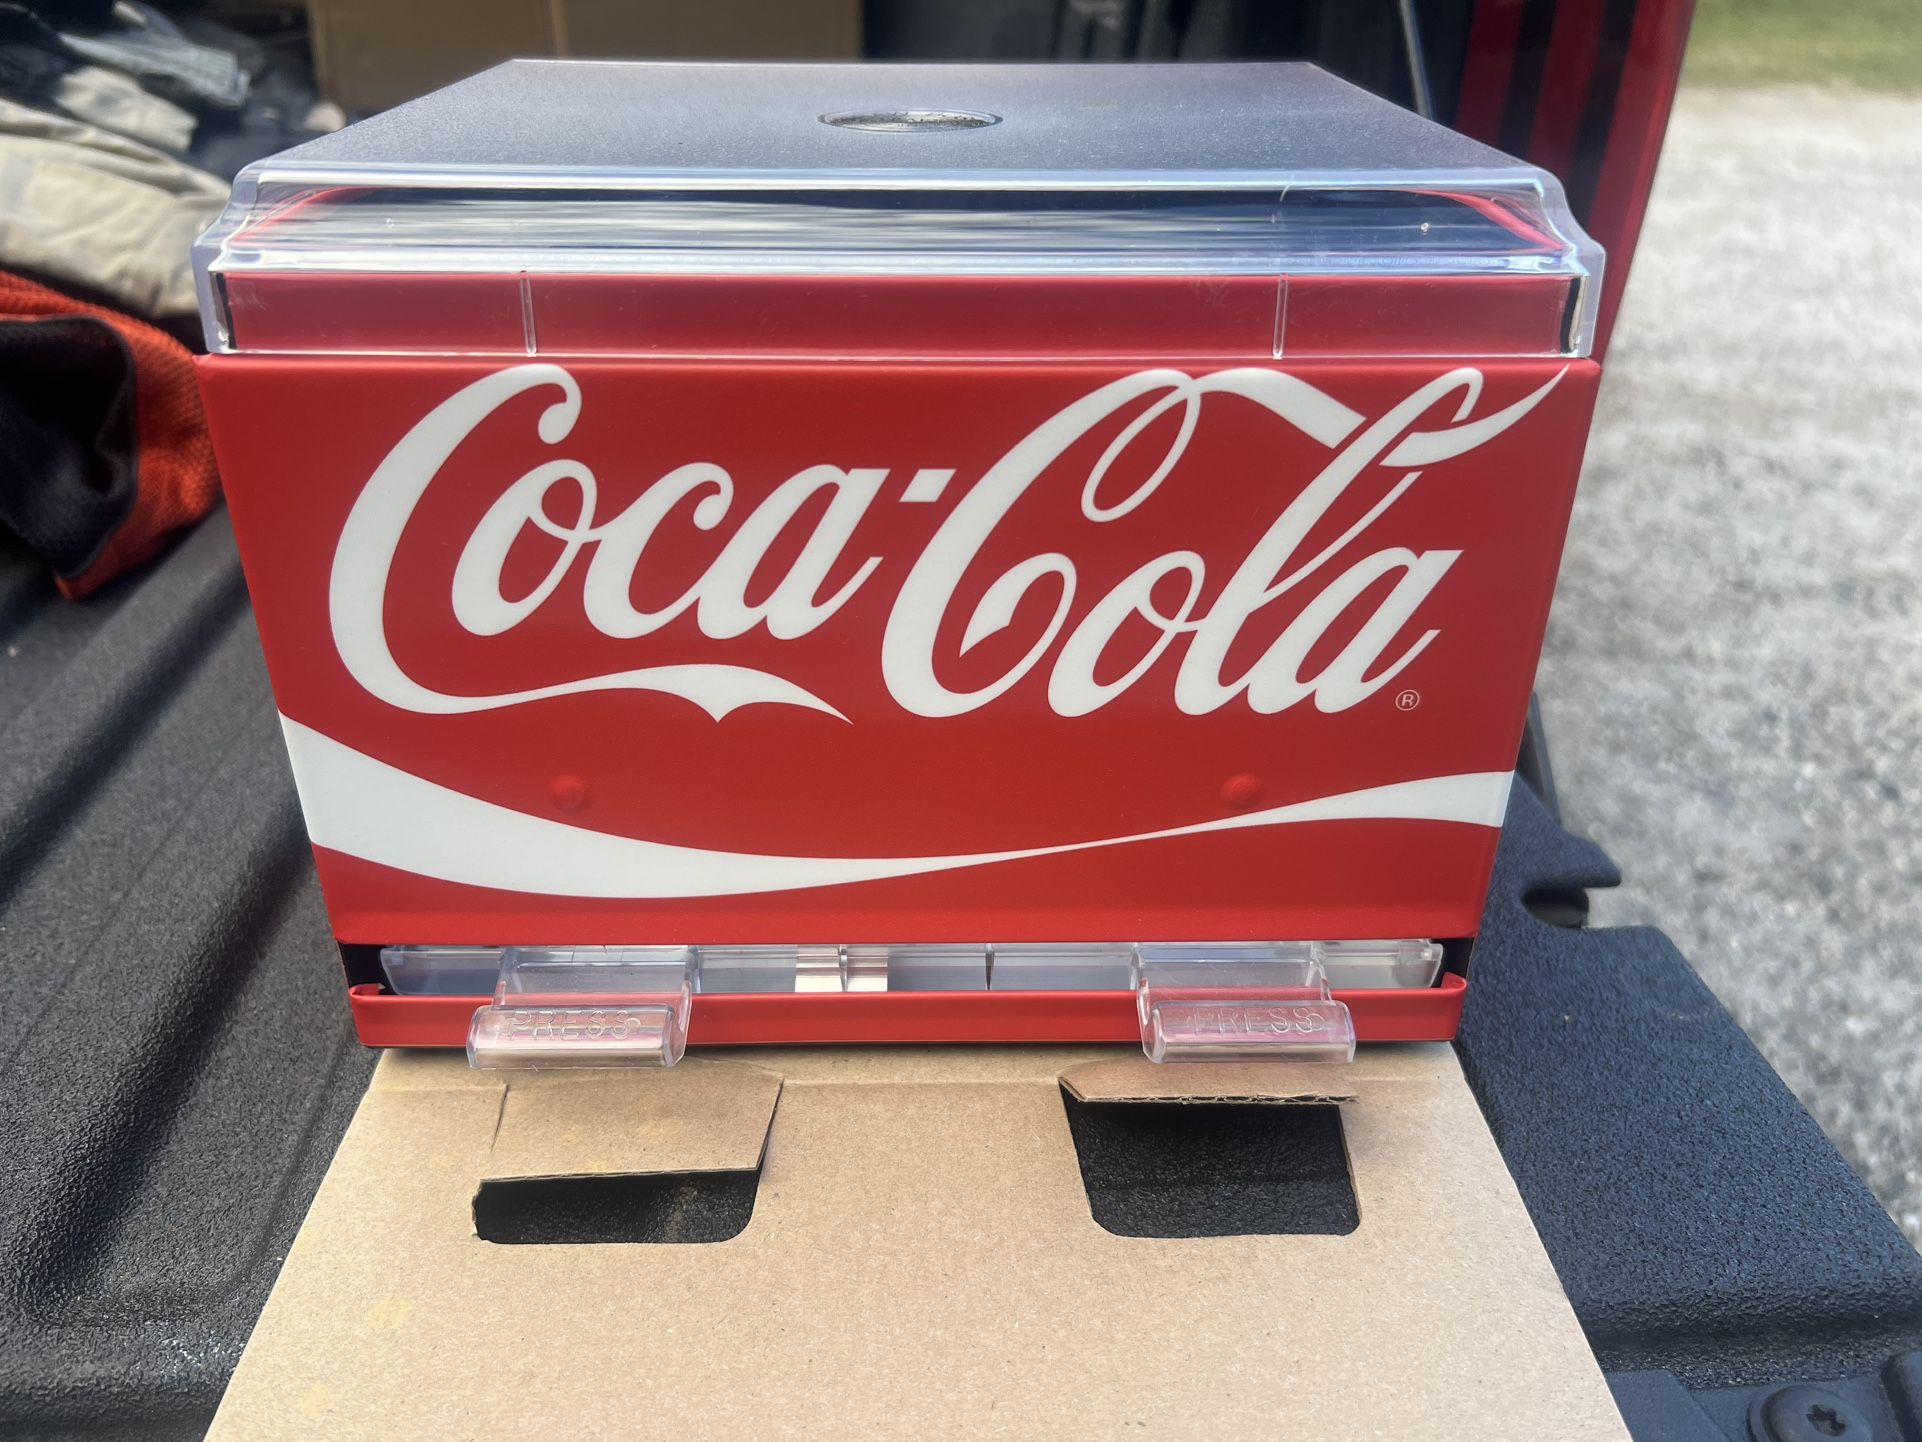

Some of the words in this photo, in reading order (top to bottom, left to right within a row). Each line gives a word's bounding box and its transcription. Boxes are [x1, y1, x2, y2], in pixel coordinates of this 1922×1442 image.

[329, 363, 1570, 724] Coca-Cola
[505, 1009, 632, 1041] PRESS
[1193, 1007, 1314, 1036] PRESS
